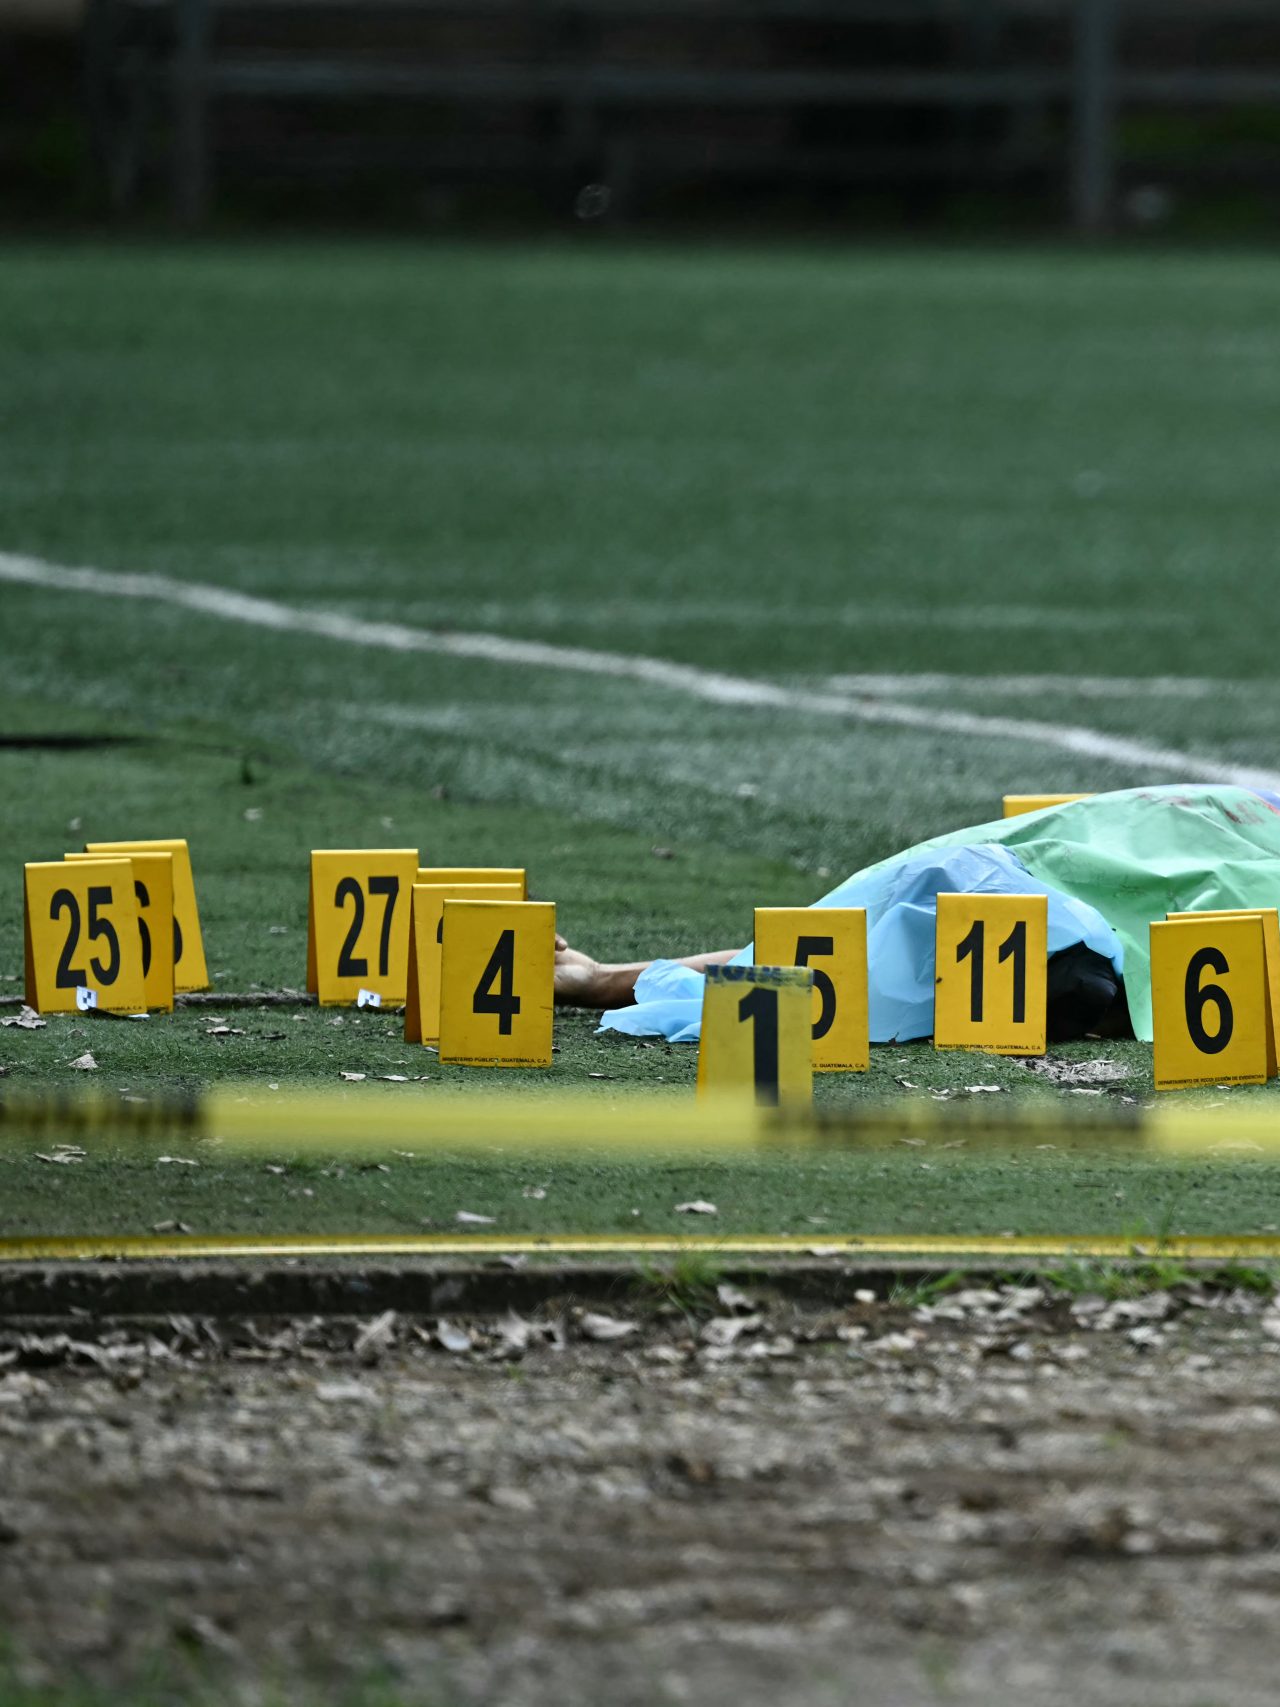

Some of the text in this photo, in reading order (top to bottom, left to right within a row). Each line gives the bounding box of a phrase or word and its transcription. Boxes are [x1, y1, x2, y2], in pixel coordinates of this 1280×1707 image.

[49, 886, 121, 989] 25
[334, 876, 400, 978] 27
[956, 920, 1028, 1024] 11
[472, 929, 521, 1036] 4
[794, 935, 837, 1041] 5
[1184, 946, 1234, 1055] 6
[738, 986, 780, 1108] 1
